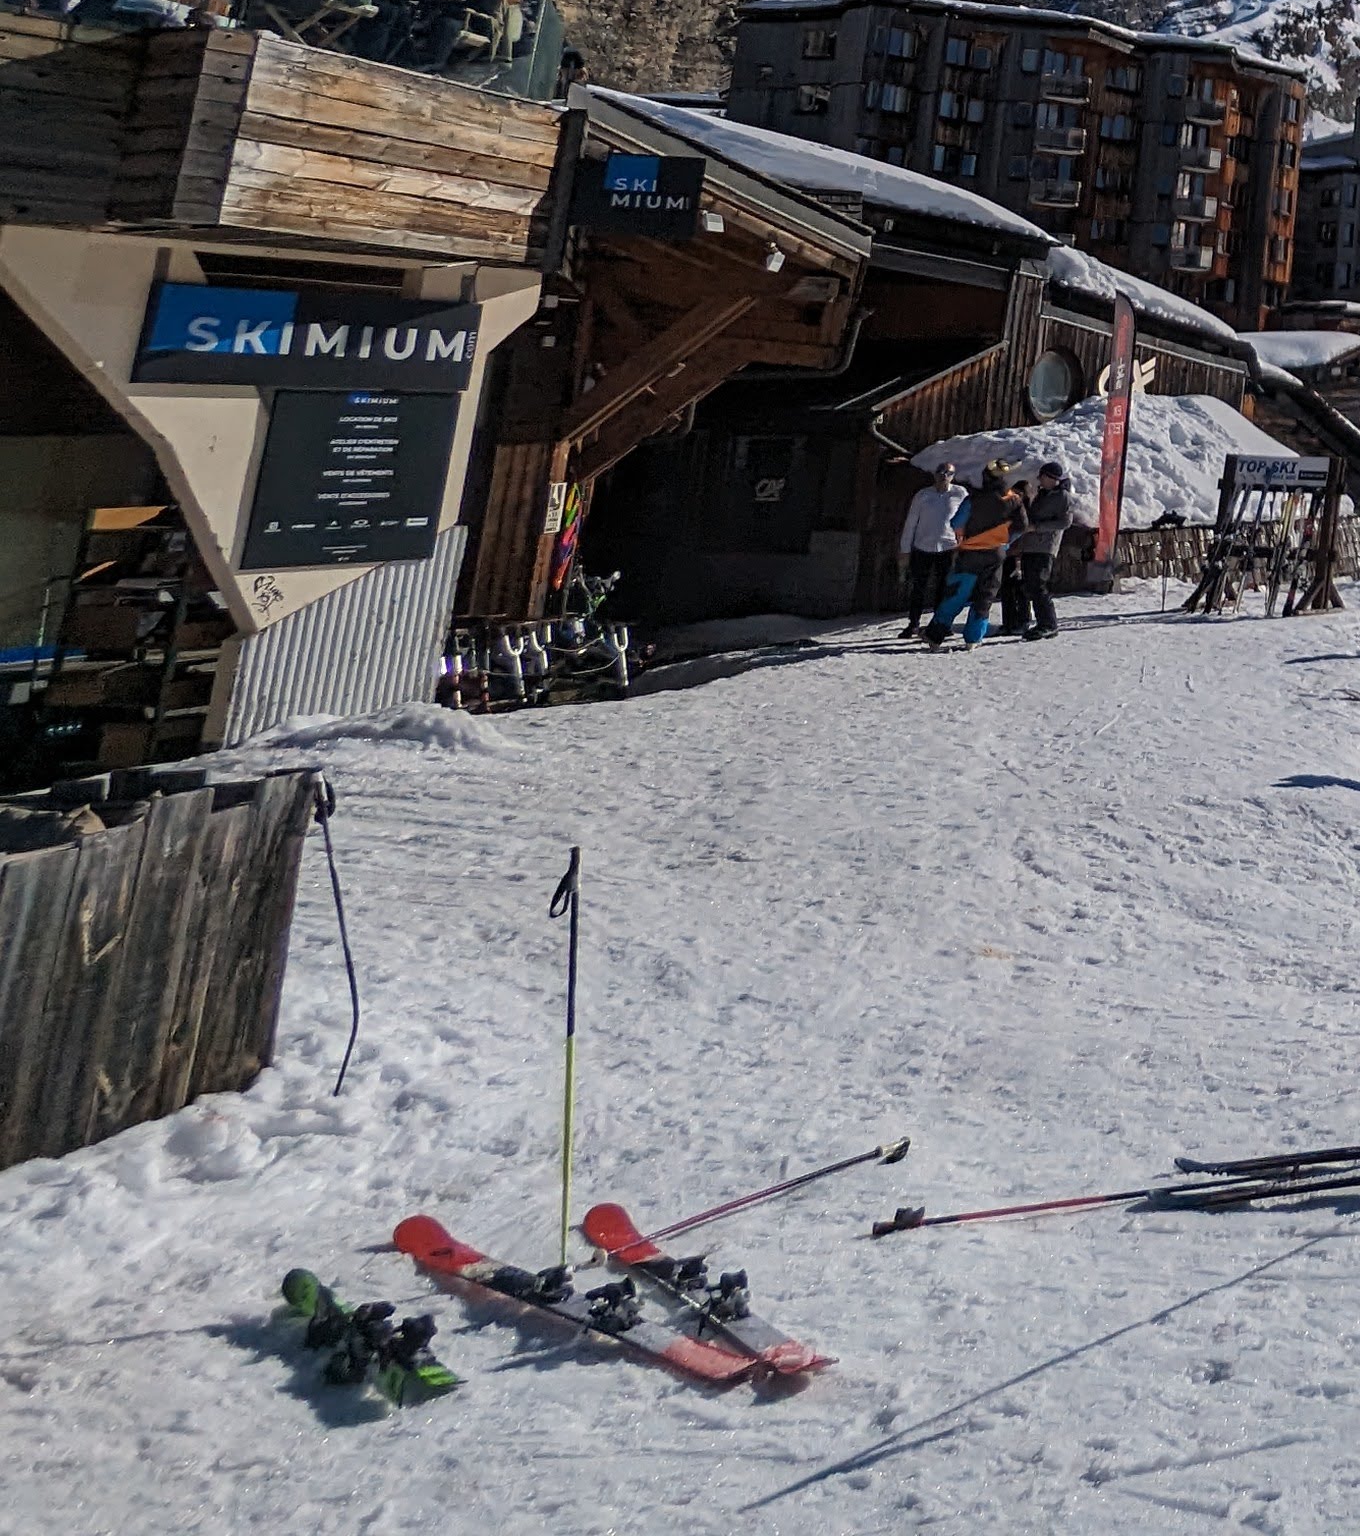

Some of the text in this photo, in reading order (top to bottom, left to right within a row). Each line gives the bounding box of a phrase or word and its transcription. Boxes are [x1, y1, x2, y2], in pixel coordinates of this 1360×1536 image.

[613, 177, 659, 193] SKI
[610, 193, 686, 210] MIUM
[184, 316, 467, 363] SKIMIUM
[1238, 459, 1298, 474] TOP SKI
